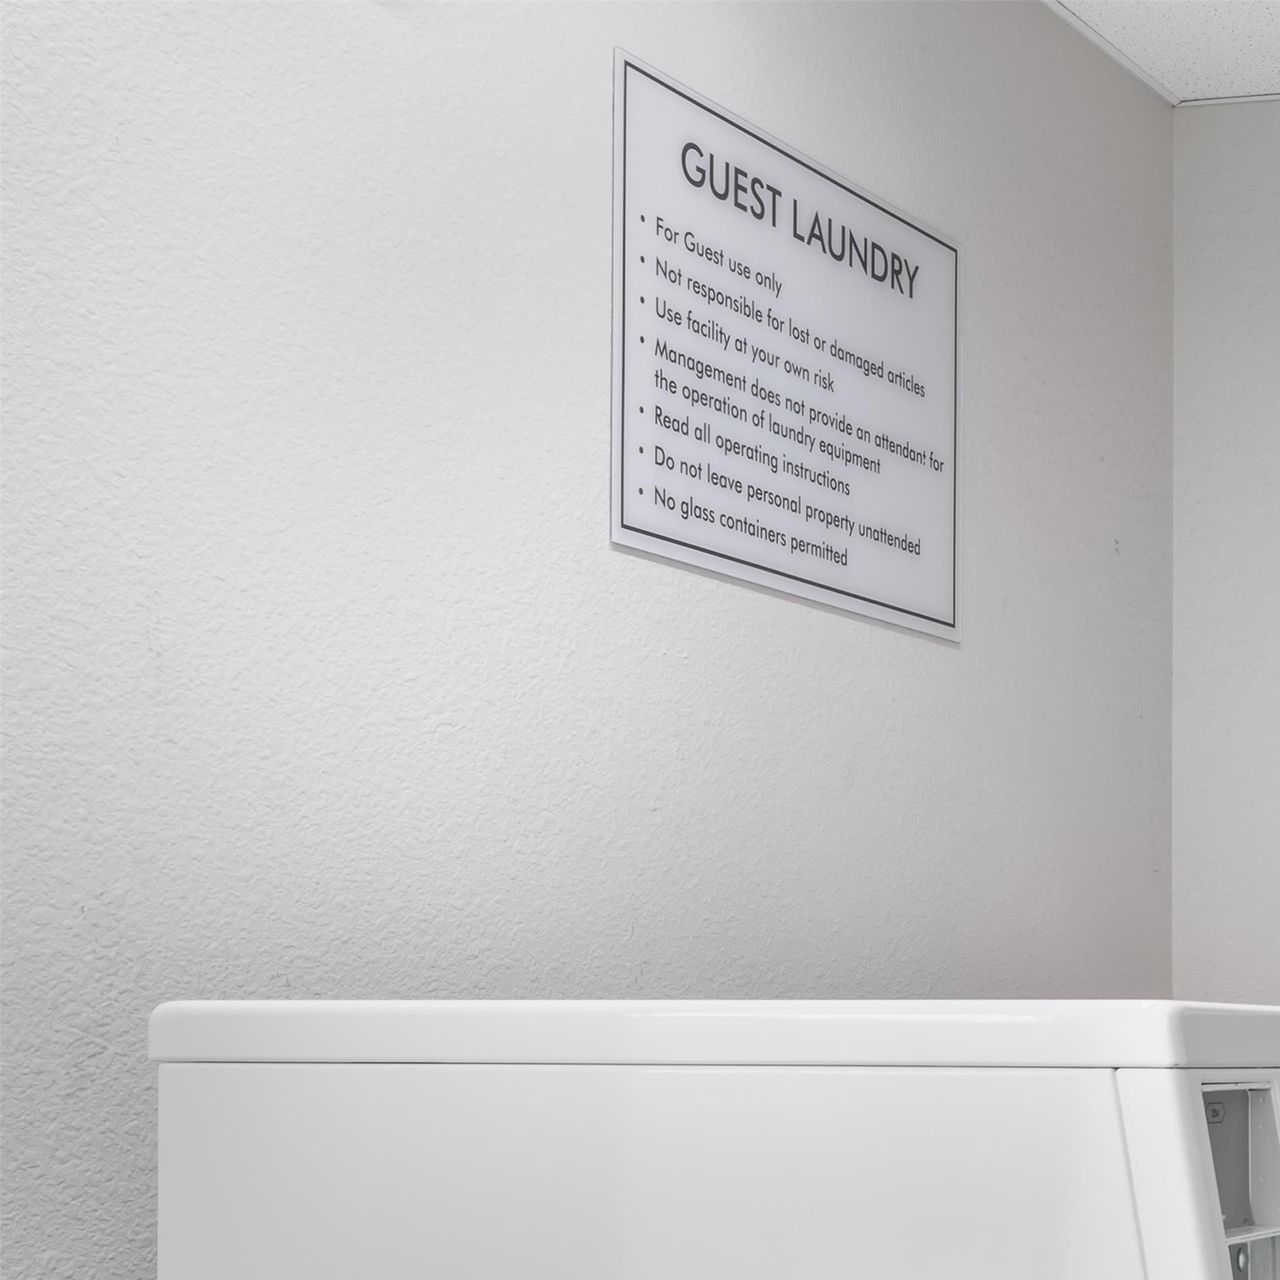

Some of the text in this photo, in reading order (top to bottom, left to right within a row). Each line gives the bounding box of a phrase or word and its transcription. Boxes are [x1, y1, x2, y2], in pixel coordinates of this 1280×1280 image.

[656, 216, 783, 298] For Guest use only
[681, 142, 920, 299] GUEST LAUNDRY
[656, 257, 926, 398] Not responsible for lost or damaged articles
[656, 297, 835, 393] Use facility at your own risk
[654, 337, 944, 473] Management does not provide an attendant for
[654, 368, 881, 474] the operation of laundry equipment
[655, 405, 850, 496] Read all operating instructions
[654, 445, 921, 556] Do not leave personal property unattended
[654, 486, 848, 566] No glass containers permitted
